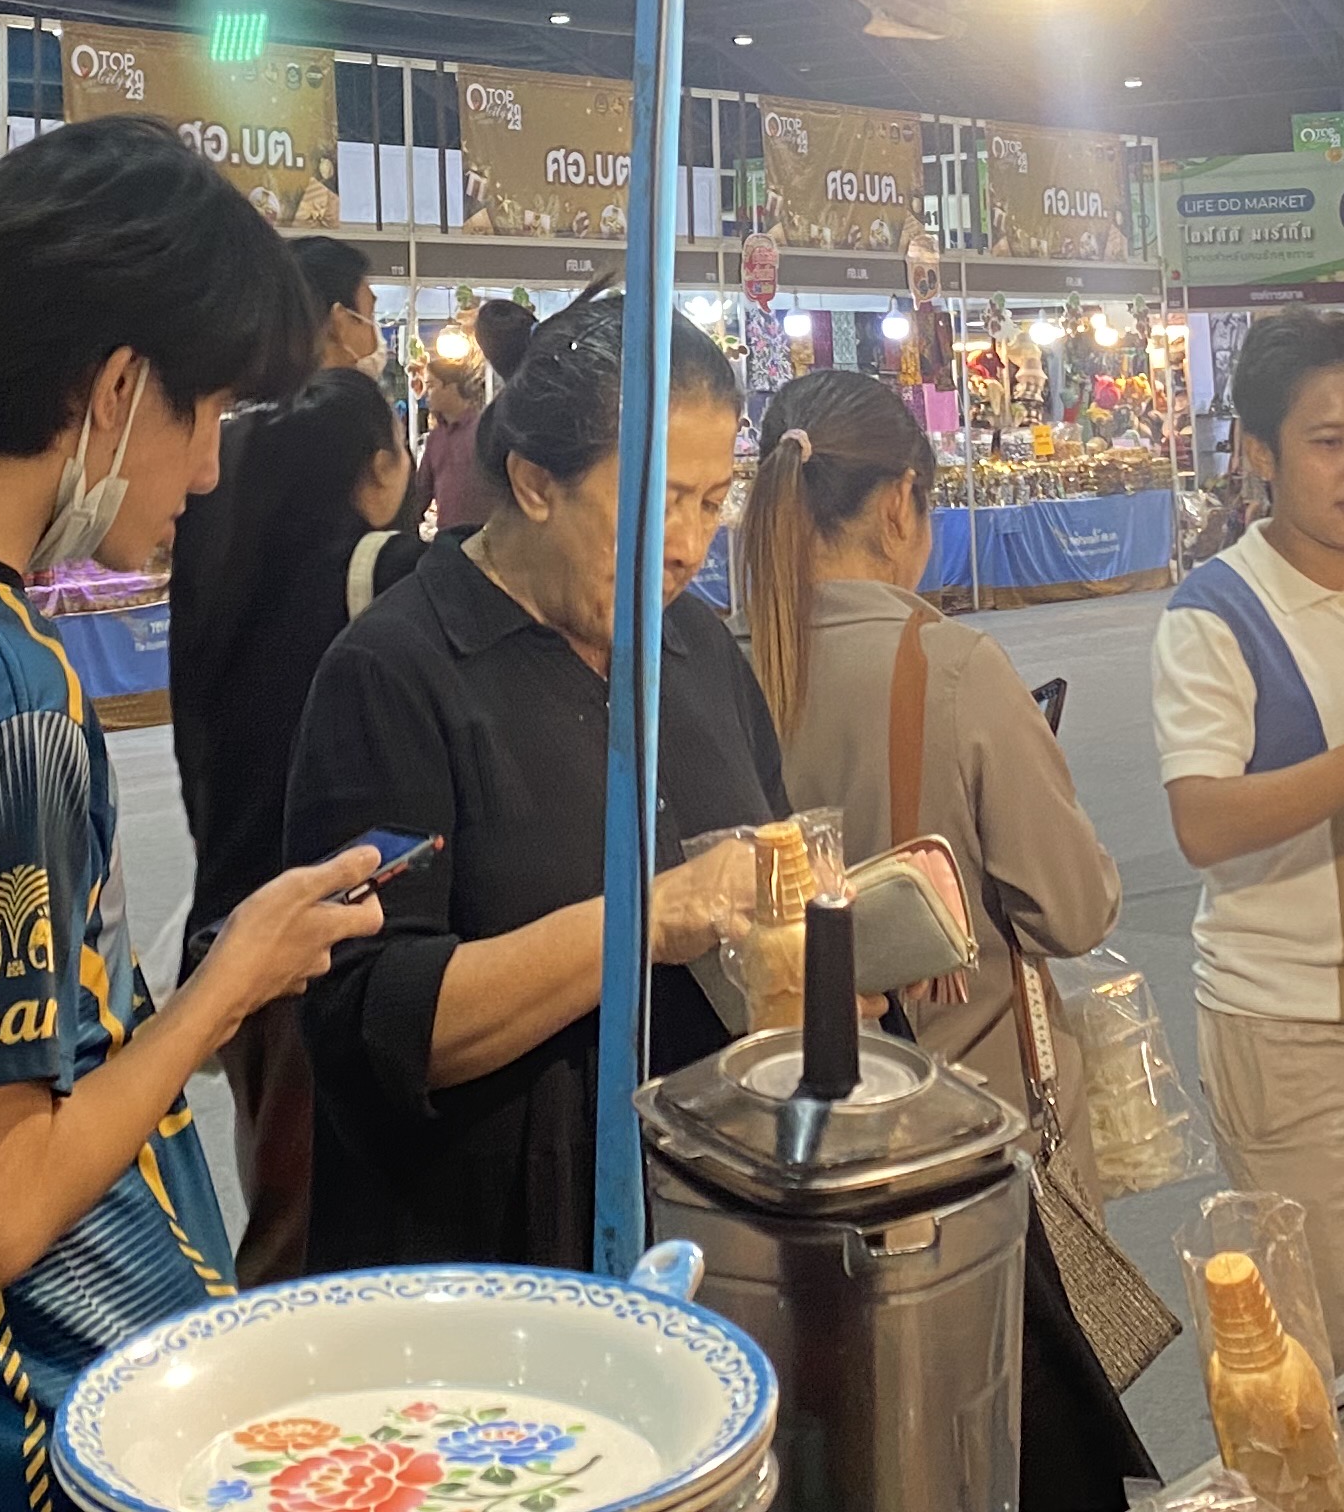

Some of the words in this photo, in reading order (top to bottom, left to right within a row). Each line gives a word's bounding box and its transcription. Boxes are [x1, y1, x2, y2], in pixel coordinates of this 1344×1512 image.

[71, 45, 135, 79] OTOP
[466, 83, 514, 111] OTOP
[546, 147, 632, 187] ศอ.บต
[826, 169, 905, 205] ศอ.บต.
[1043, 187, 1109, 219] ศอ.บต.
[1185, 199, 1214, 214] LIFE
[1218, 198, 1242, 212] DD
[1245, 194, 1308, 211] MARKET
